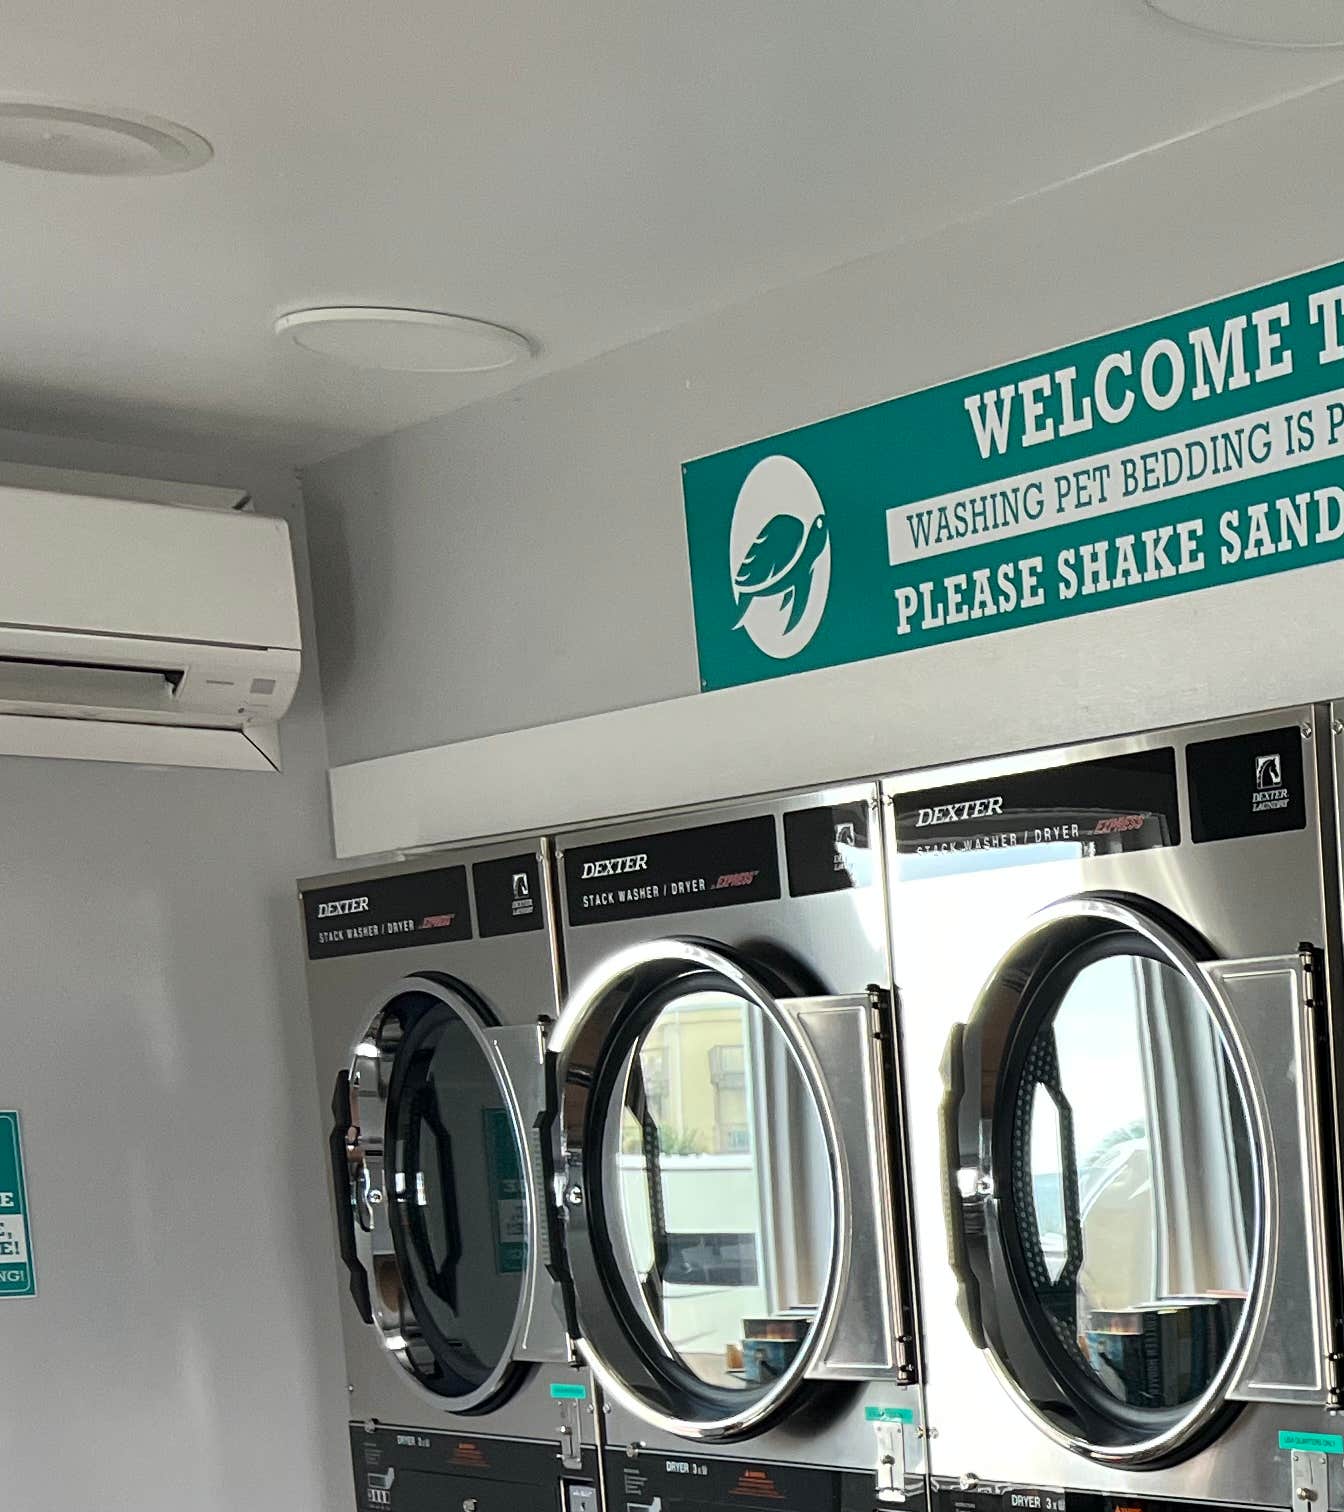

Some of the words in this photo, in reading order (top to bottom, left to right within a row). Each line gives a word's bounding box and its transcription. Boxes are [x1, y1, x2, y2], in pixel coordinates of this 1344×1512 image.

[965, 302, 1292, 459] WELCOME
[907, 483, 1043, 549] WASHING
[1056, 466, 1109, 514] PET
[1121, 423, 1271, 496] BEDDING
[1285, 413, 1315, 455] IS
[894, 555, 1044, 635] PLEASE
[1057, 520, 1204, 600] SHAKE
[1252, 789, 1288, 802] DEXTER
[916, 797, 1003, 827] DEXTER
[963, 834, 1016, 851] WASHER
[1035, 824, 1079, 842] DRYER
[1094, 816, 1144, 834] EXPRESS
[581, 854, 647, 879] DEXTER
[318, 897, 369, 918] DEXTER
[583, 892, 615, 908] STACK
[618, 884, 659, 901] WASHER
[672, 879, 705, 894] DRYER
[319, 931, 343, 943] STACK
[347, 925, 378, 939] WASHER
[388, 920, 414, 934] DRYER
[1011, 1494, 1040, 1509] DRYER
[1046, 1498, 1052, 1509] 3
